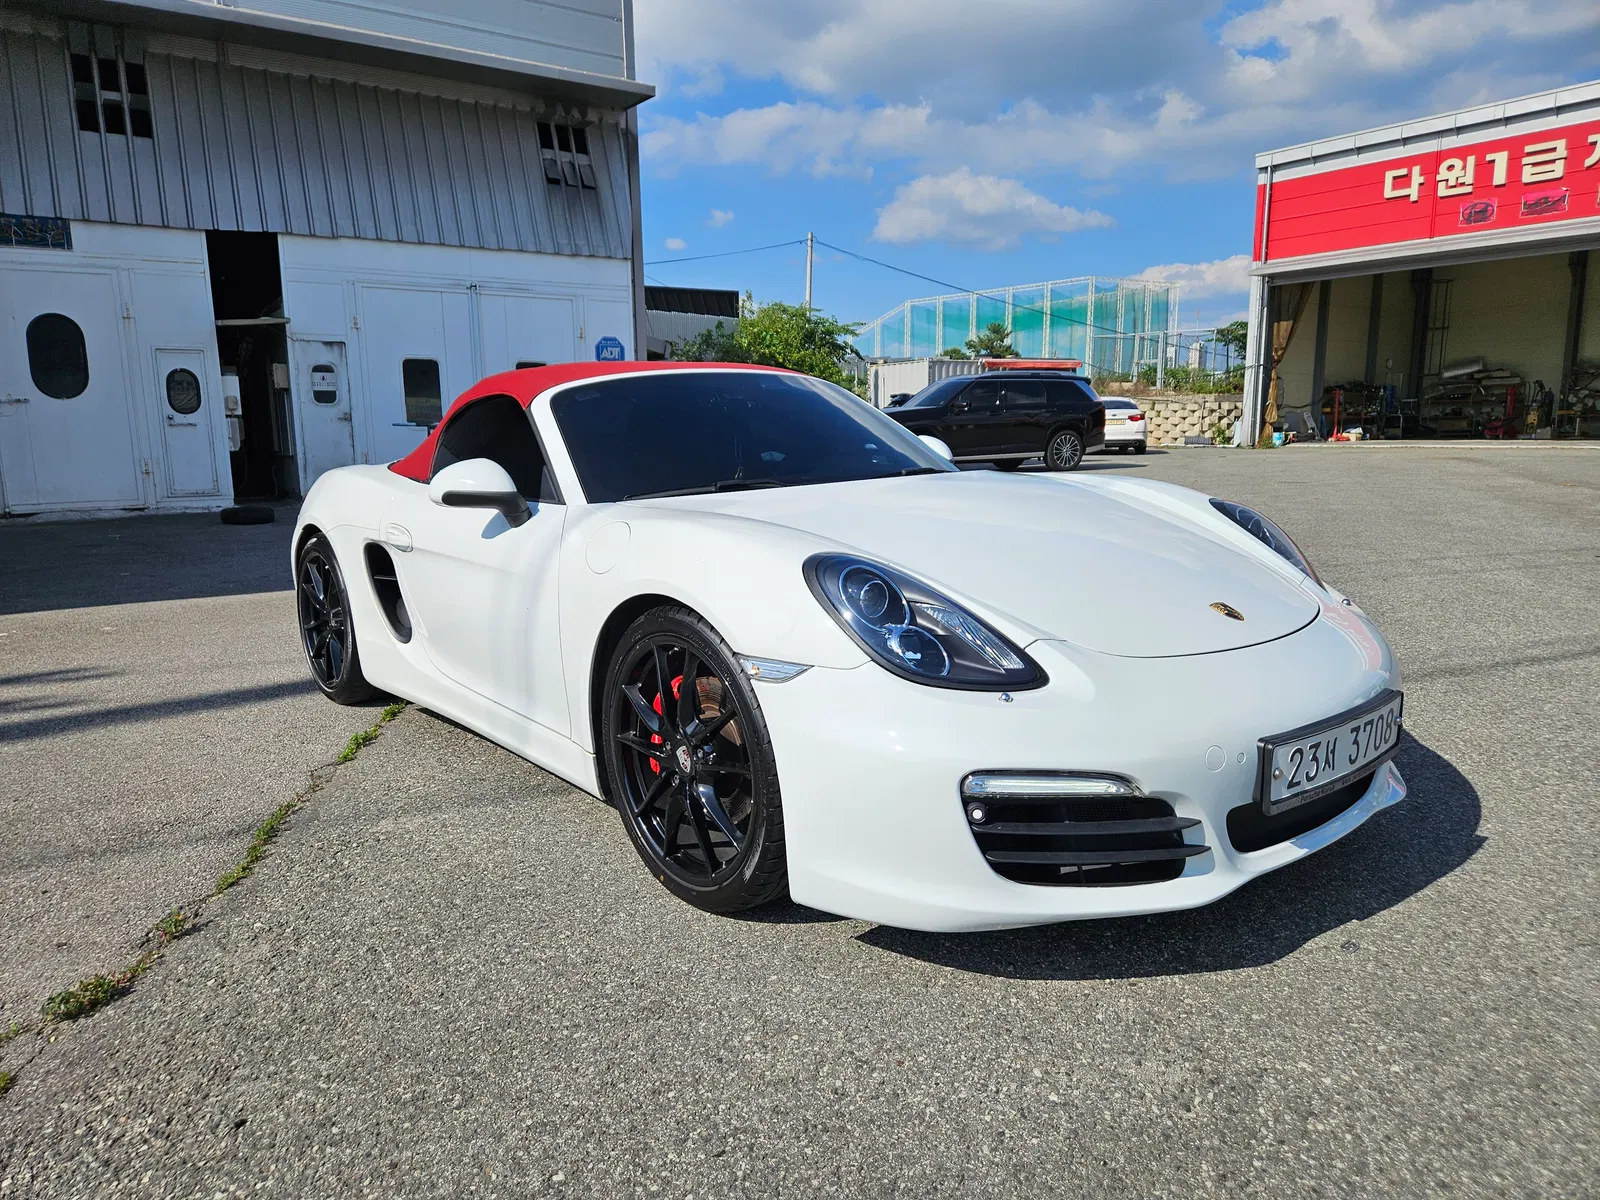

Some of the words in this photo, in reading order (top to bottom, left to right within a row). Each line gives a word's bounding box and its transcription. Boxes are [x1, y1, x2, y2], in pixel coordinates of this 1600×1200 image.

[601, 347, 620, 359] ADT
[1287, 737, 1338, 789] 23서
[1349, 708, 1394, 765] 3708
